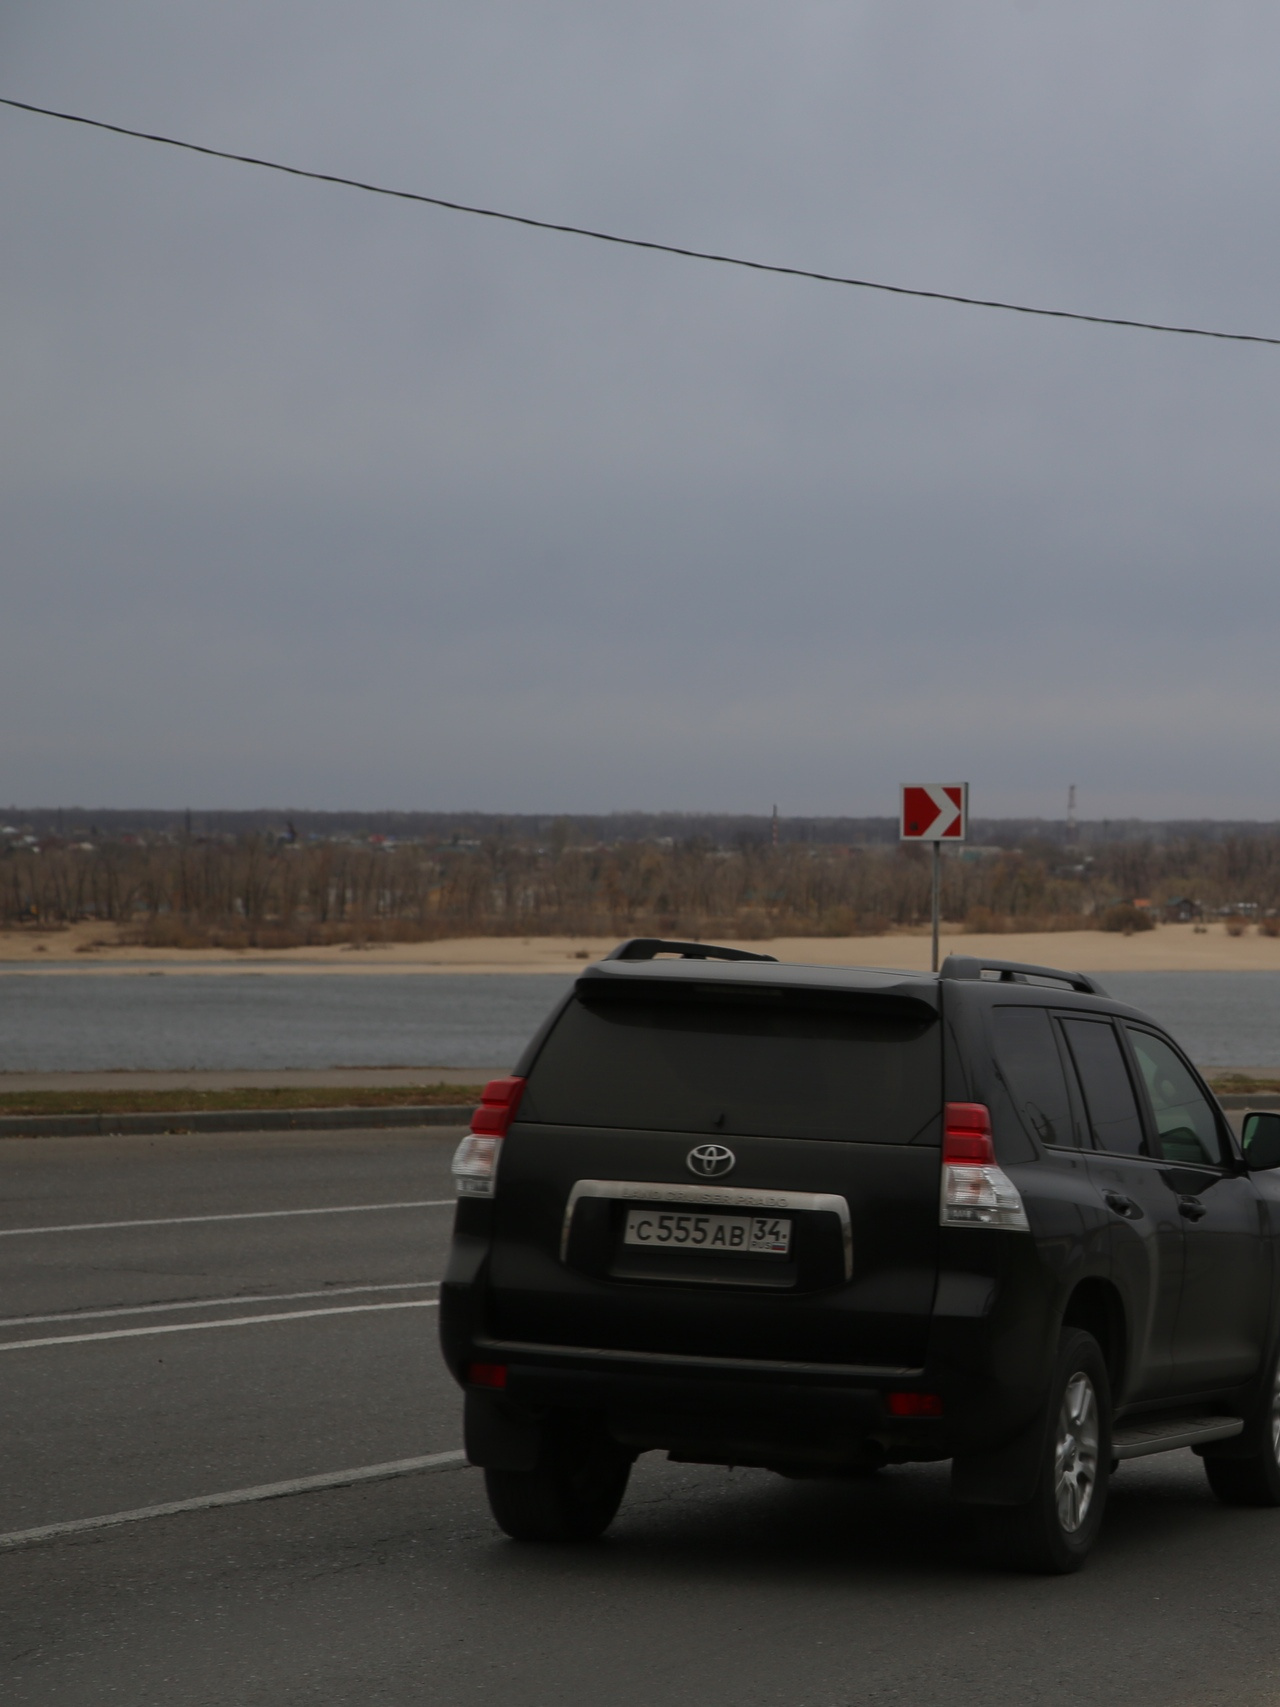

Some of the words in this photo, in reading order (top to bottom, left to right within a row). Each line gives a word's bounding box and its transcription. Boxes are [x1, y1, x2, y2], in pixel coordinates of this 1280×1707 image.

[622, 1187, 659, 1200] LAND
[665, 1190, 733, 1205] CRUISER
[736, 1194, 788, 1208] PRADO
[753, 1219, 781, 1242] 34
[751, 1241, 771, 1250] RUS
